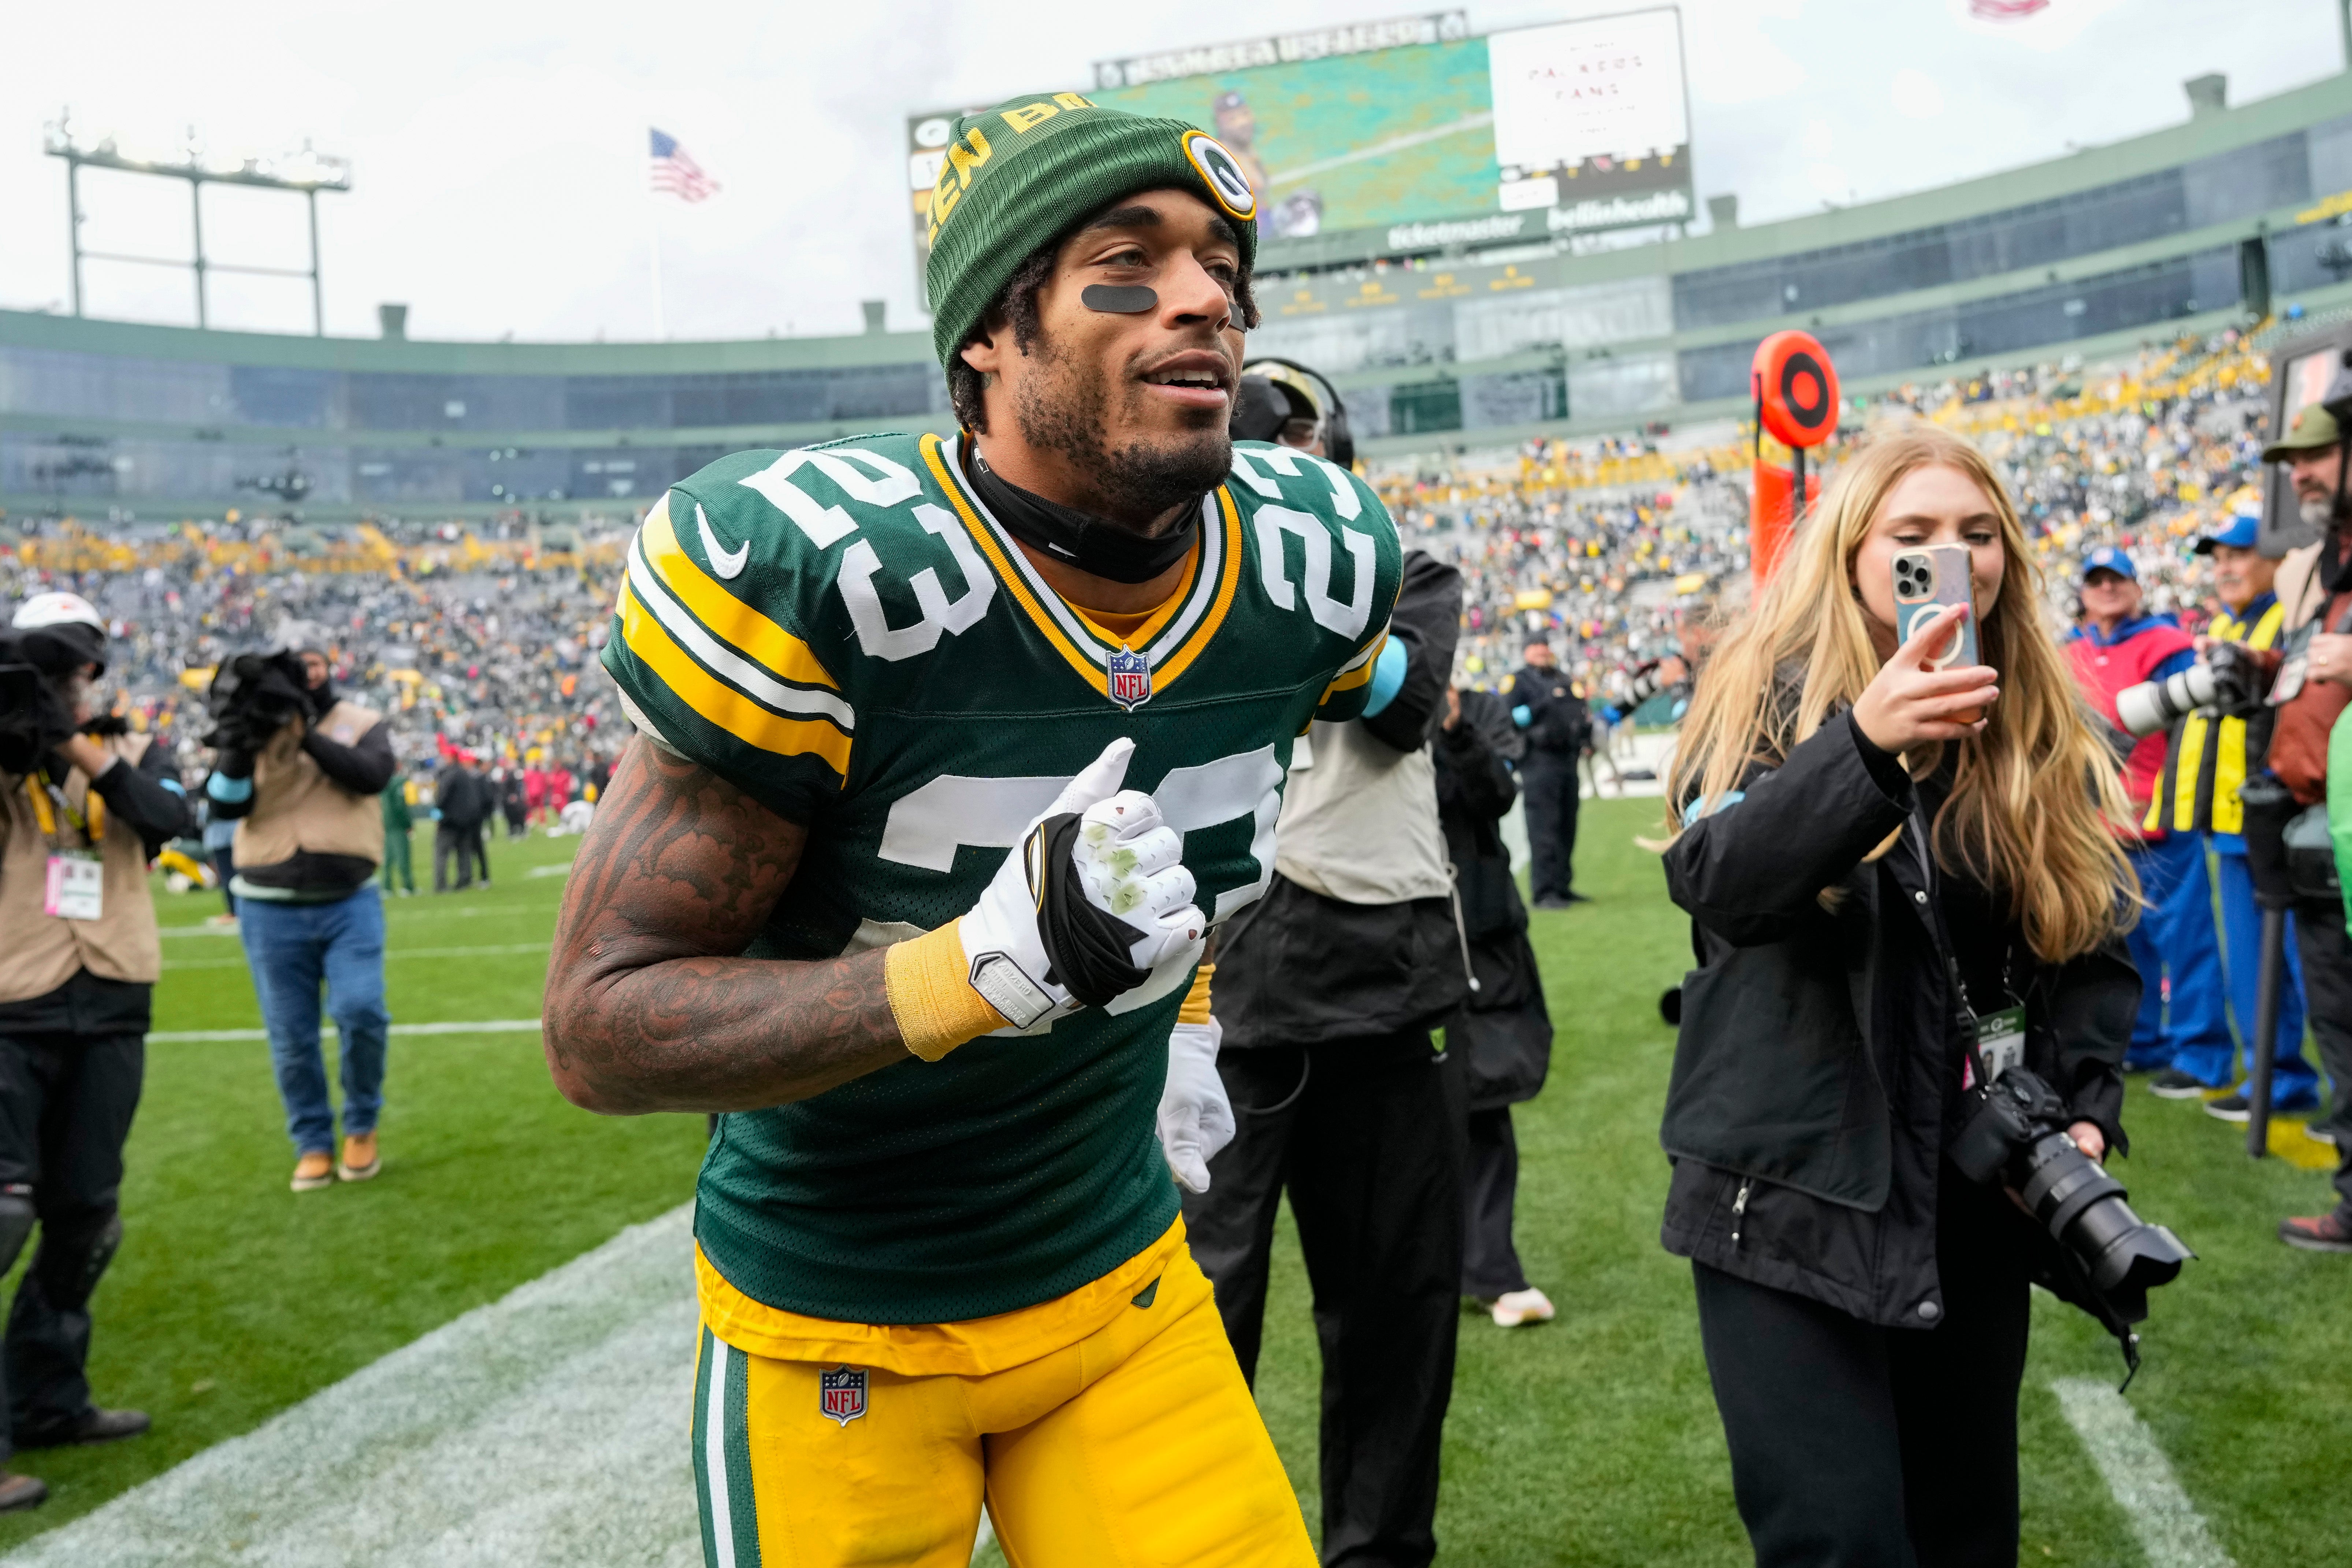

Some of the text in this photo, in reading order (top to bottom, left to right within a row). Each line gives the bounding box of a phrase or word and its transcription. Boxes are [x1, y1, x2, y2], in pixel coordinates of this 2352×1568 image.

[1190, 136, 1254, 212] G
[737, 448, 997, 662] 23
[1232, 447, 1376, 642] 23
[1116, 675, 1146, 700] NFL
[989, 969, 1007, 991] PULL
[999, 963, 1032, 995] ADIZERO
[827, 1390, 860, 1413] NFL
